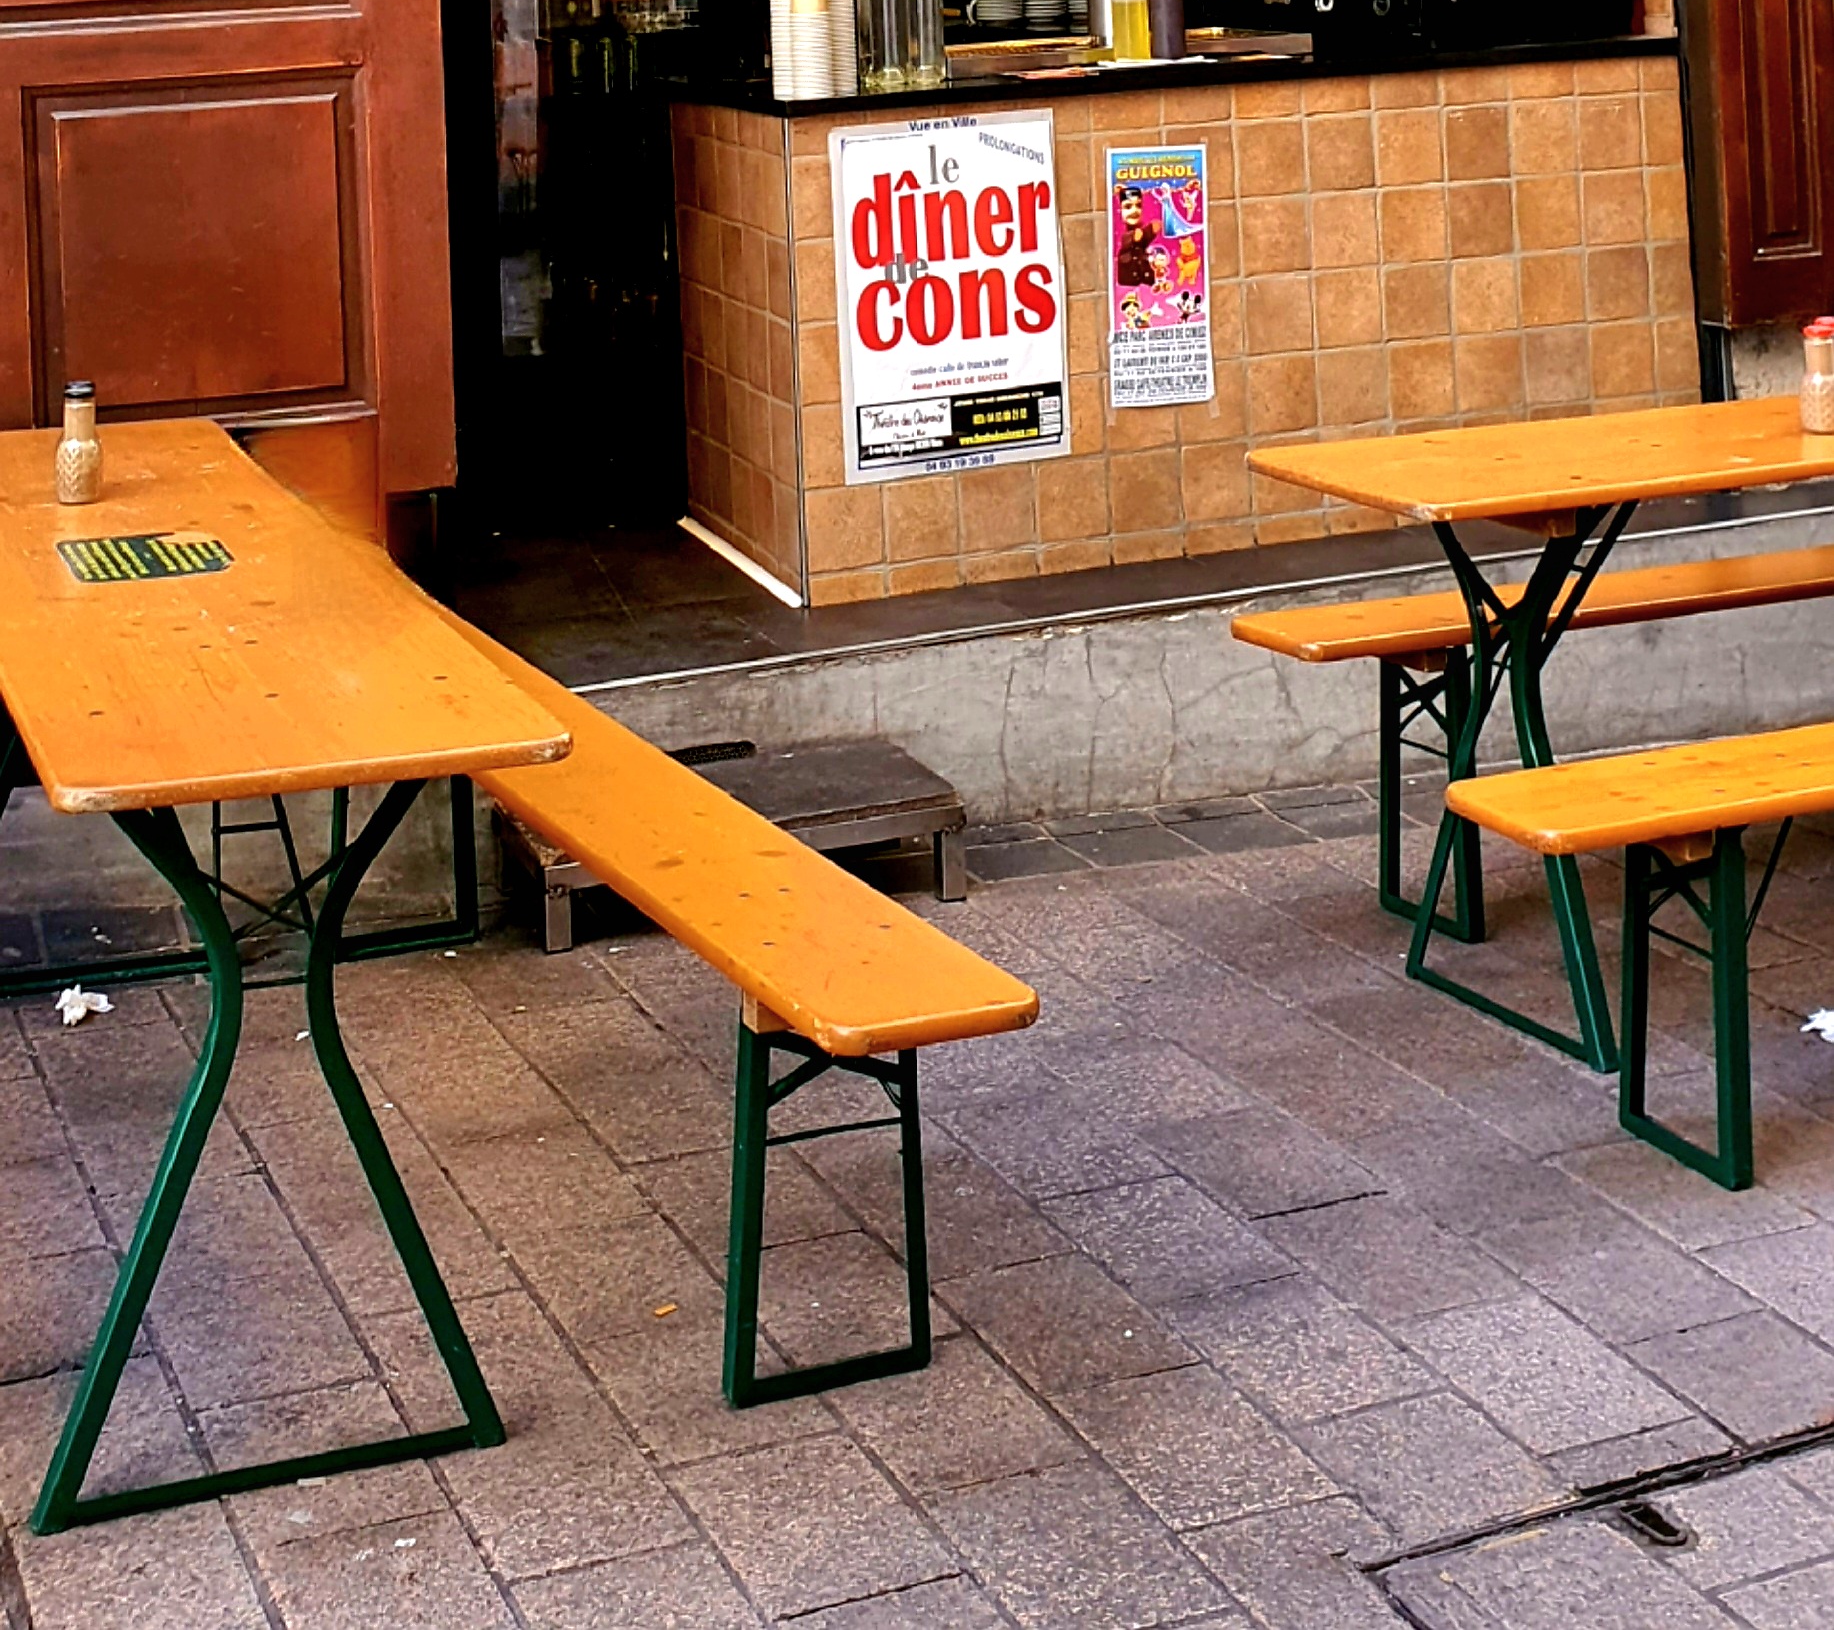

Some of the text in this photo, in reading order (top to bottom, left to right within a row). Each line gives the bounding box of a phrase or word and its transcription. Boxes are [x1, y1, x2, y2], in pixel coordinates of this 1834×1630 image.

[909, 121, 931, 132] Vue
[933, 120, 949, 130] en
[928, 144, 960, 185] le
[1116, 165, 1197, 180] GUIGNOL
[851, 170, 1051, 270] dîner
[884, 252, 929, 284] de
[856, 263, 1058, 352] cons
